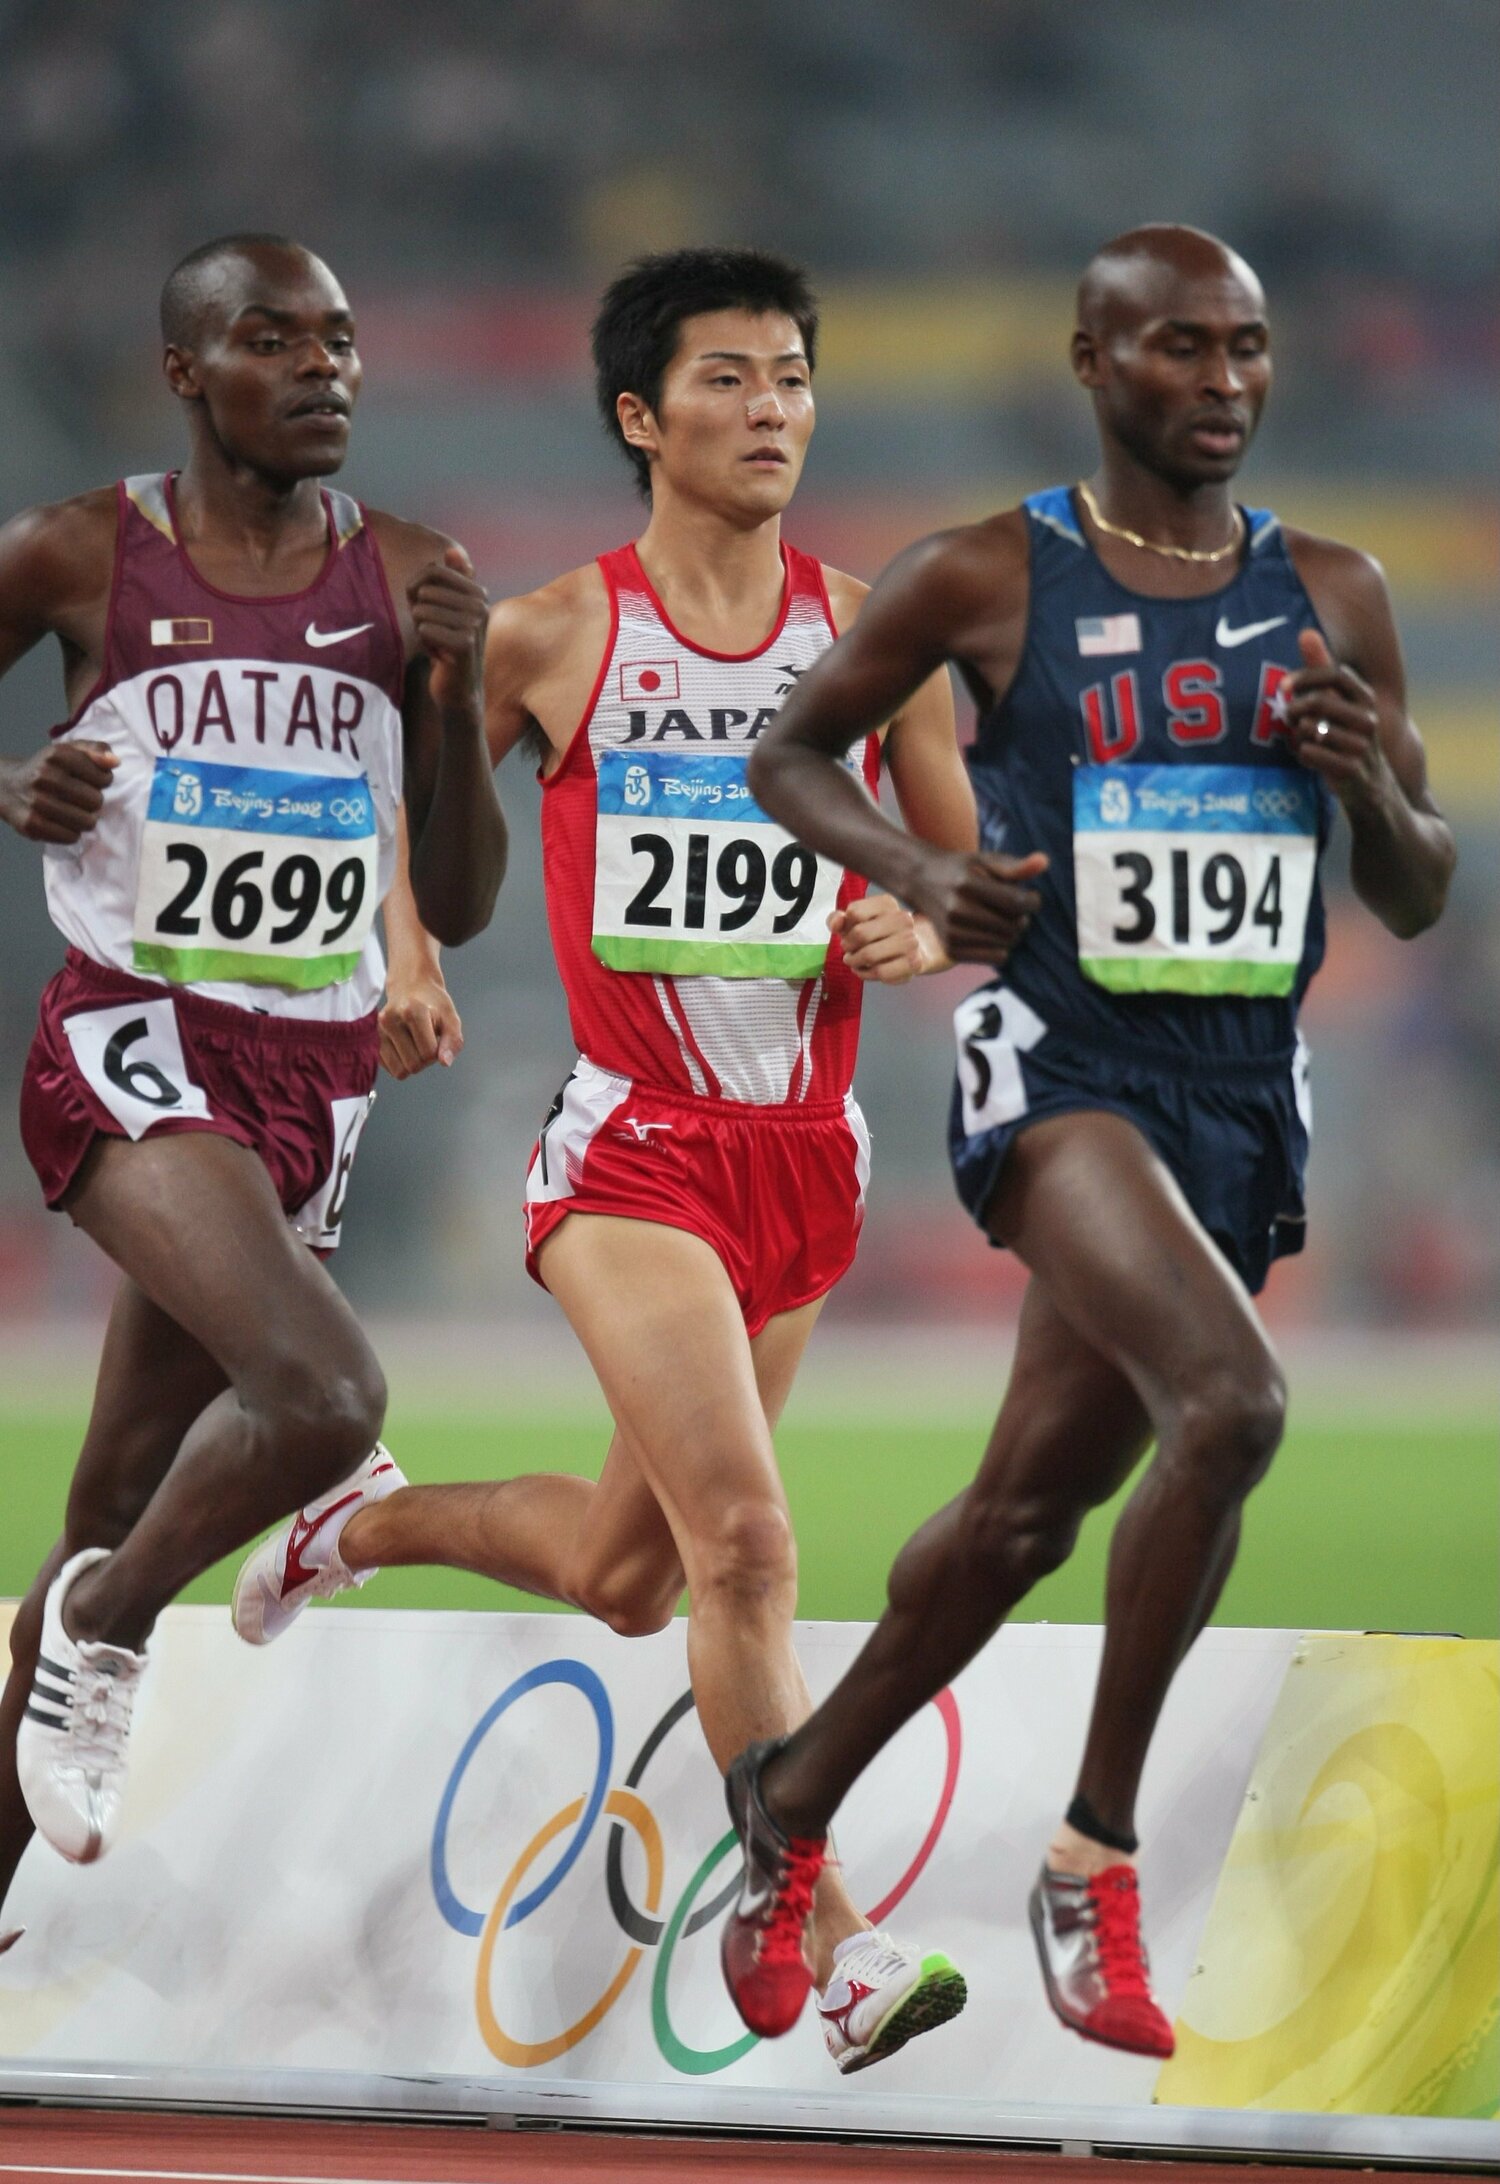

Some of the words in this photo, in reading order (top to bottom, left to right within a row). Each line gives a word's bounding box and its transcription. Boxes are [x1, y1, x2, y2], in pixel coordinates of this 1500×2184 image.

[146, 669, 365, 761] QATAR
[618, 707, 779, 744] JAPA
[210, 788, 273, 818] Beijing
[277, 798, 322, 818] 2008
[658, 778, 722, 804] Beijing
[725, 784, 750, 799] 20
[155, 843, 366, 946] 2699
[624, 833, 818, 934] 2199
[1113, 850, 1283, 948] 3194
[103, 1017, 182, 1106] 6
